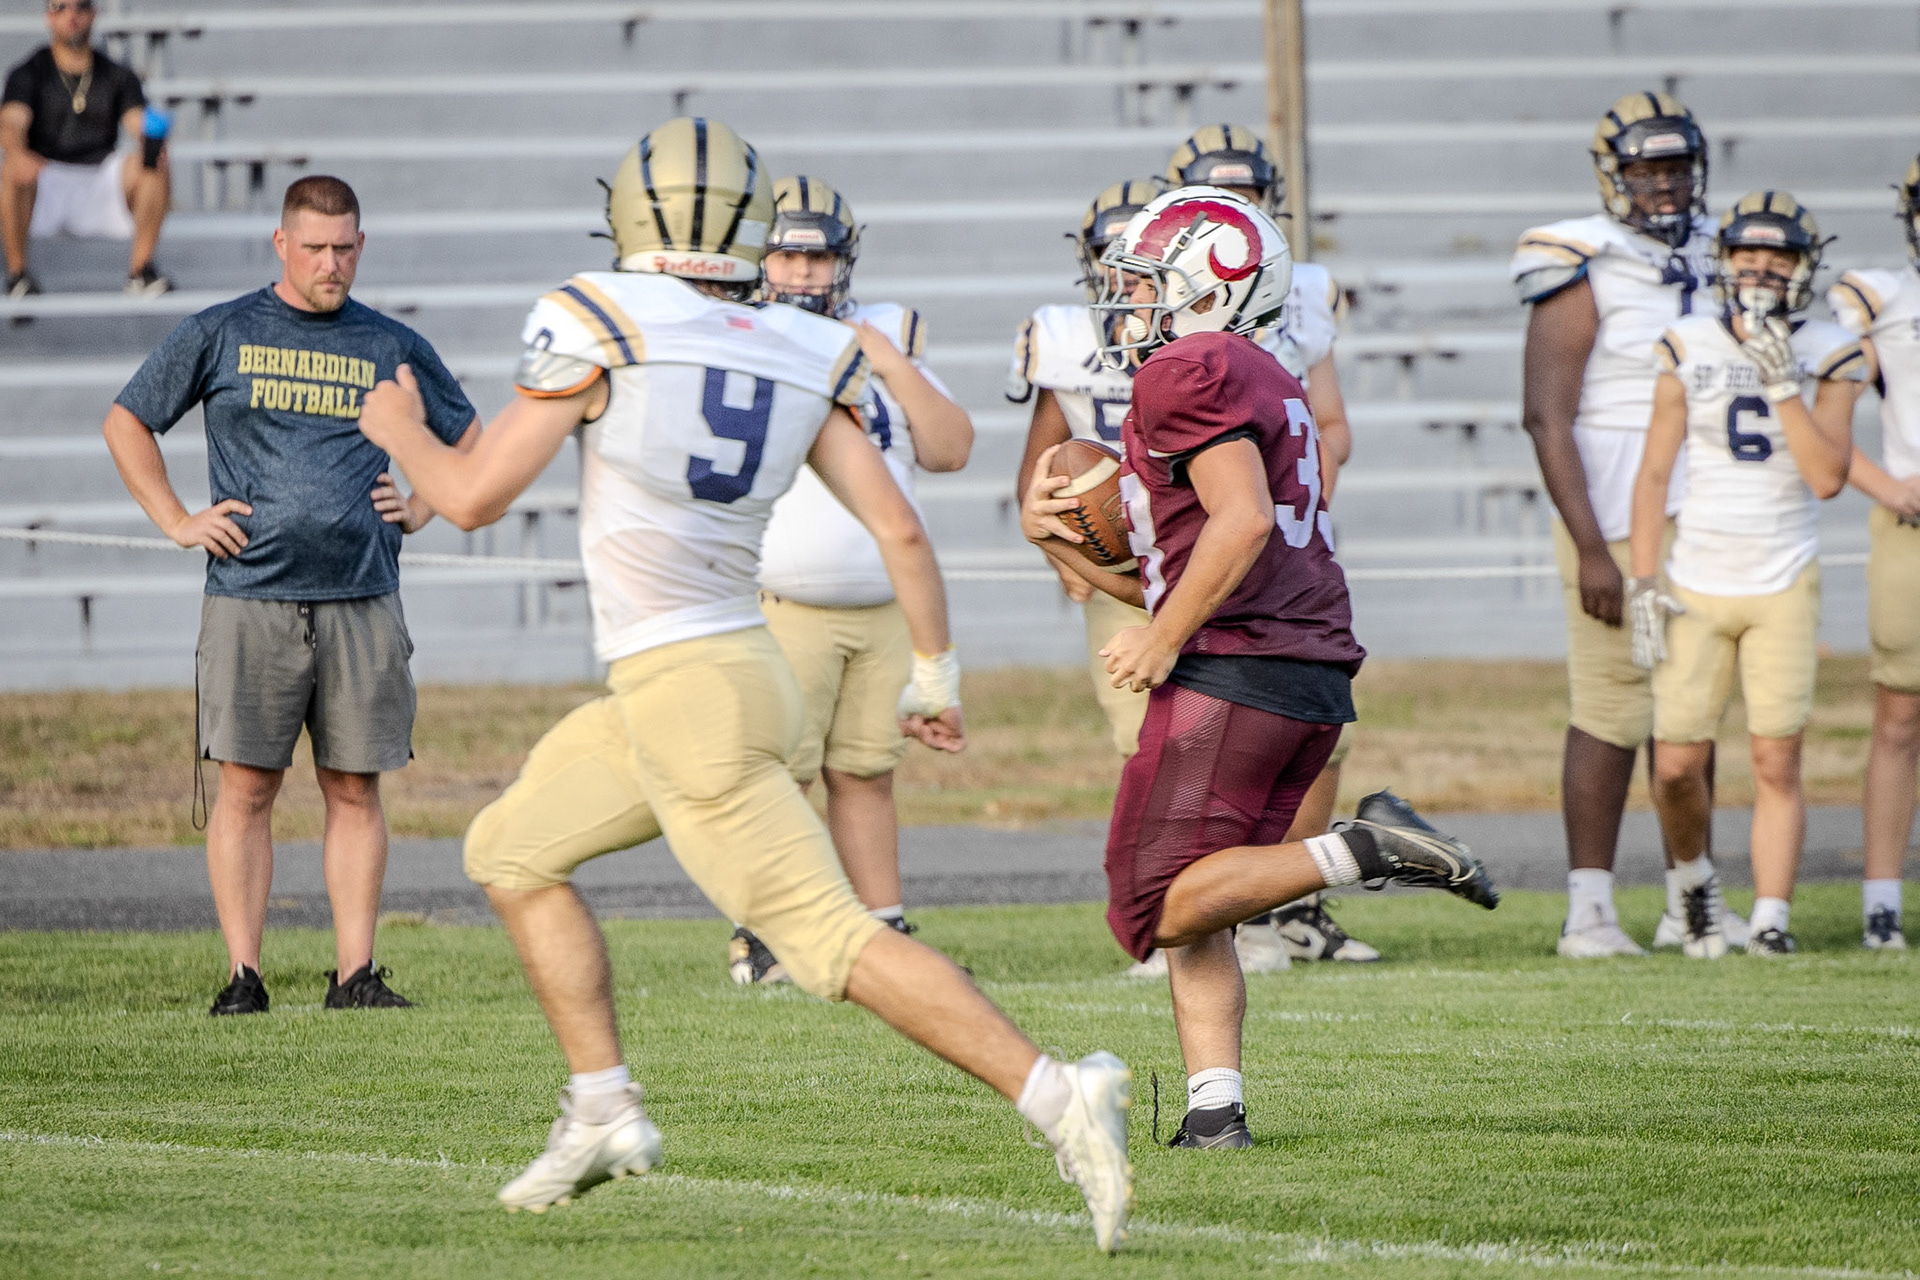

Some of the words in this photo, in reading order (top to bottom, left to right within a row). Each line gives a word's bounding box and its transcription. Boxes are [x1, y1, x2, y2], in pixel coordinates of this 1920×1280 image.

[652, 255, 736, 277] Riddell
[237, 344, 376, 390] BERNARDIAN
[250, 377, 361, 419] FOOTBALL
[687, 366, 775, 504] 9
[1727, 396, 1773, 462] 6
[1274, 398, 1336, 553] 3
